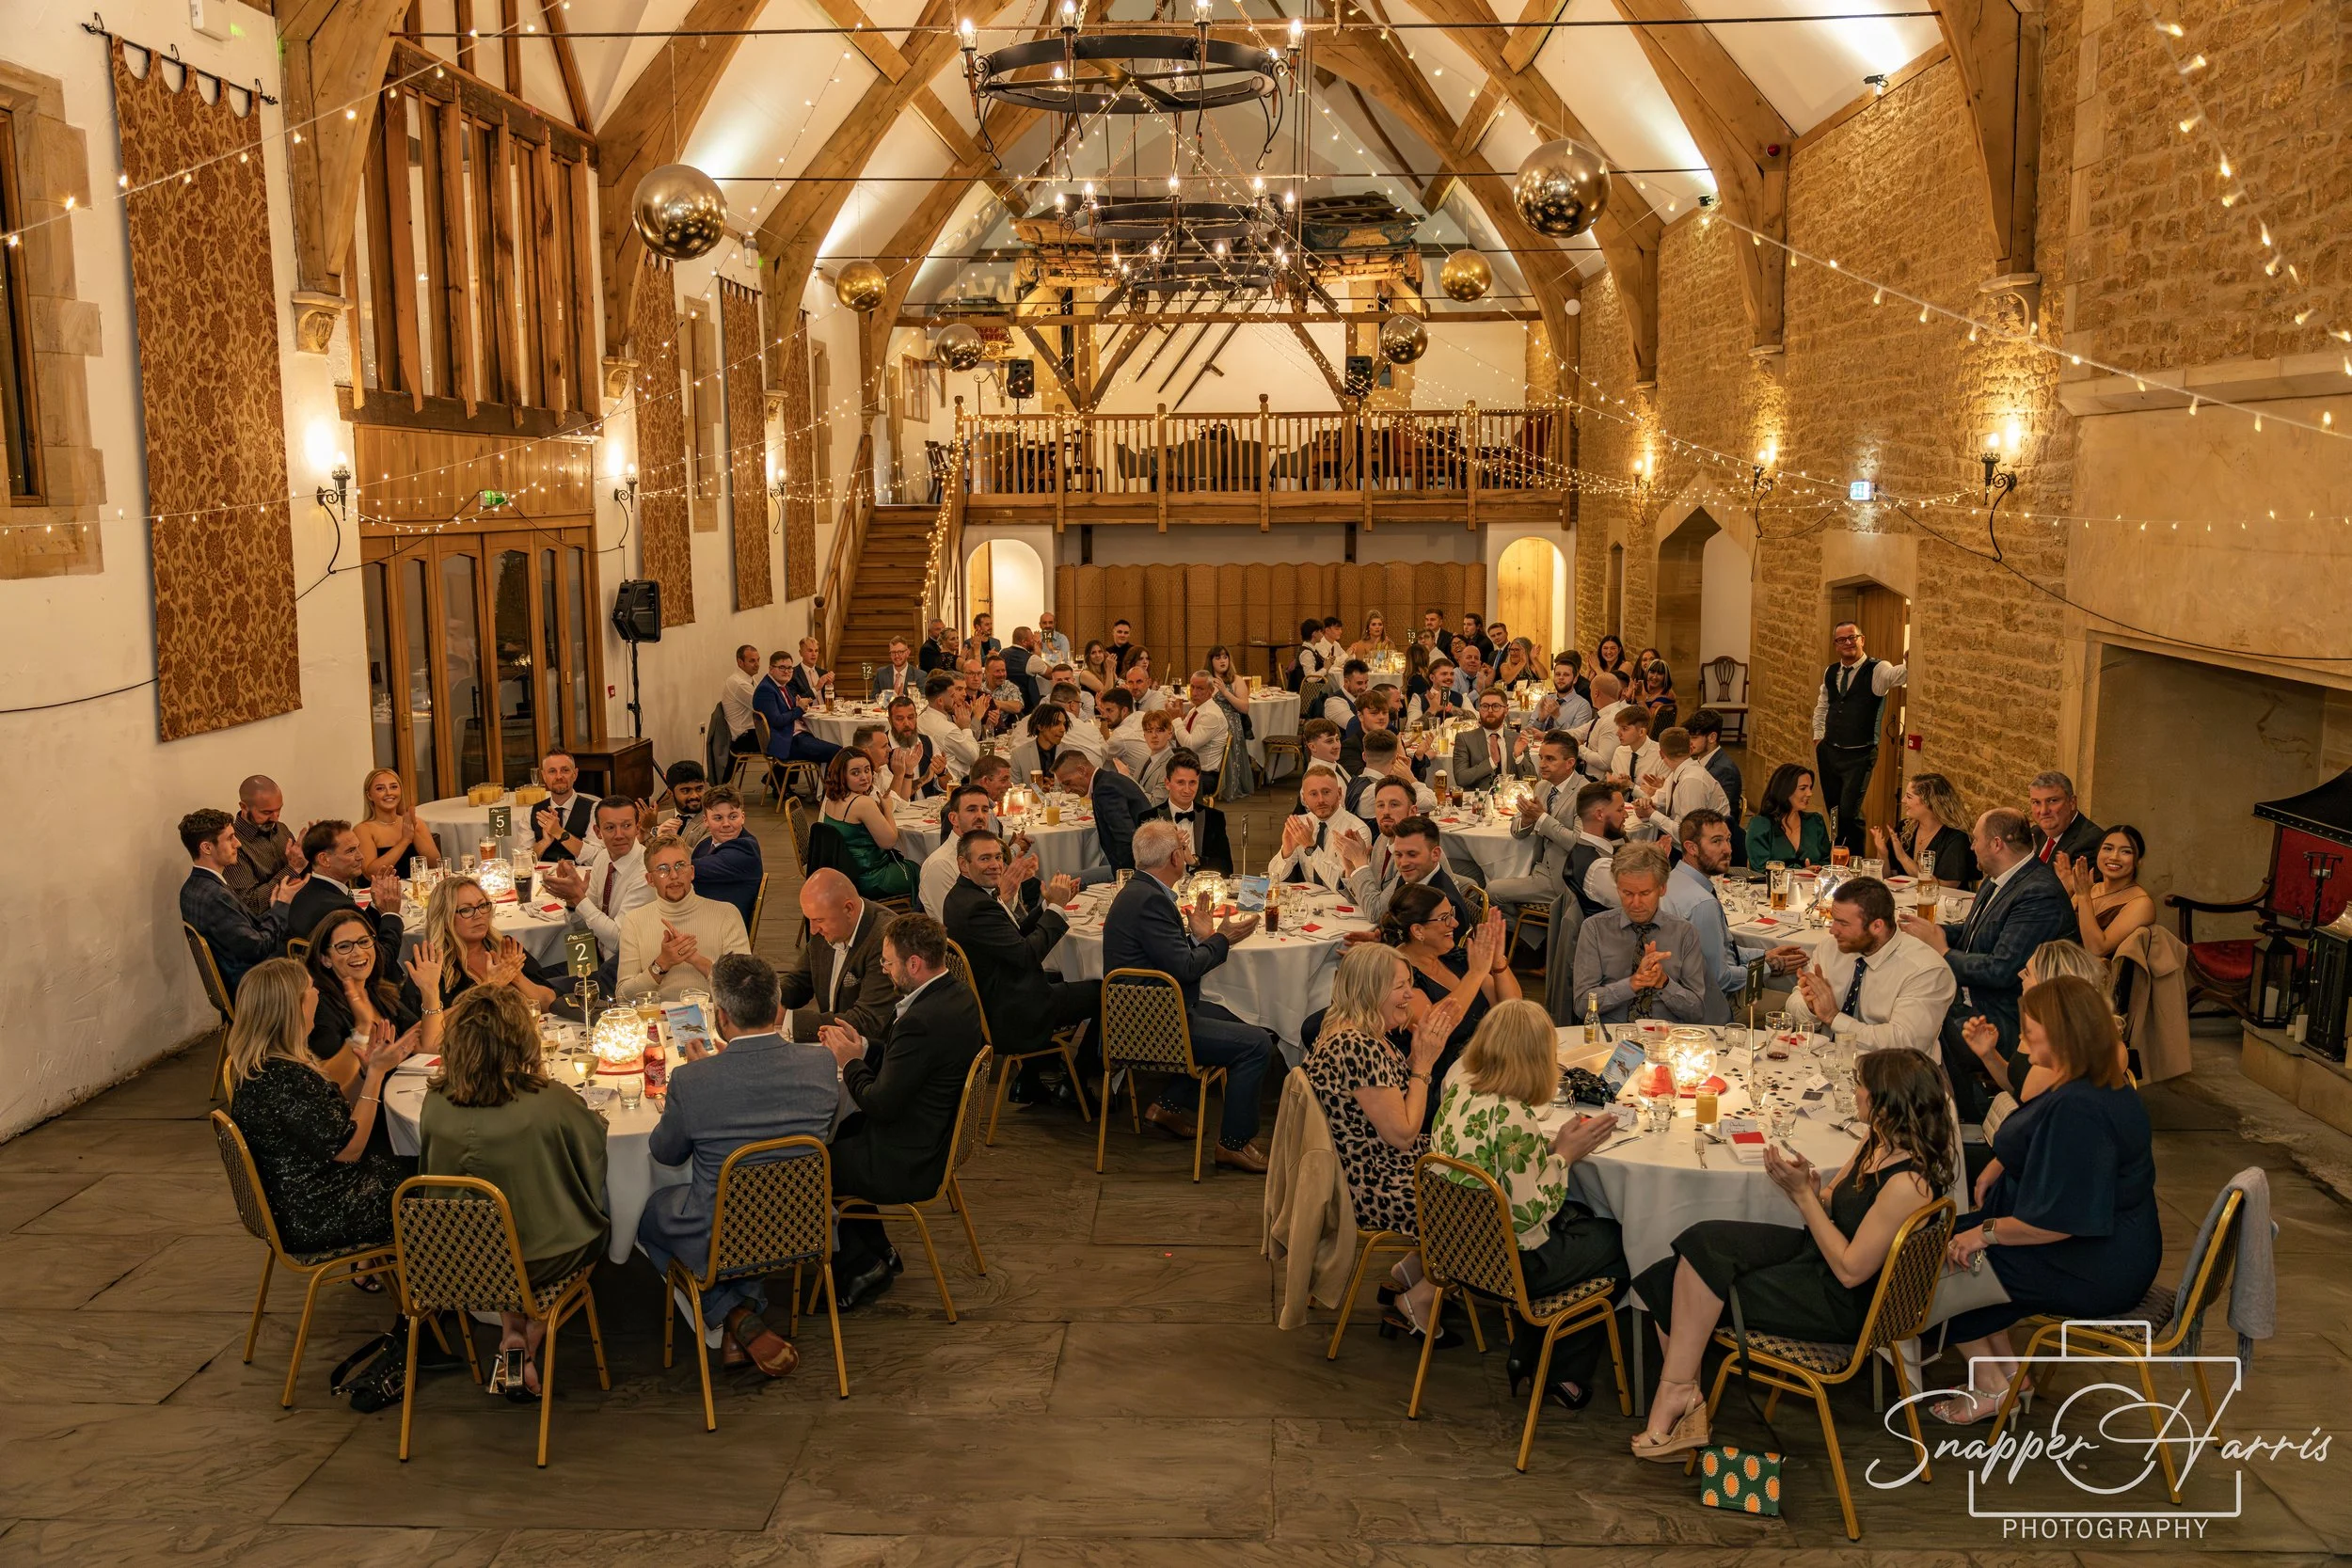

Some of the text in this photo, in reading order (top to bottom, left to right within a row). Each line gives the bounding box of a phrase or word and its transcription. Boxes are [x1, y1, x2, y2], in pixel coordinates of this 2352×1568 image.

[983, 748, 991, 756] 7
[496, 815, 505, 828] 5
[575, 942, 589, 961] 2
[1752, 969, 1757, 989] 1
